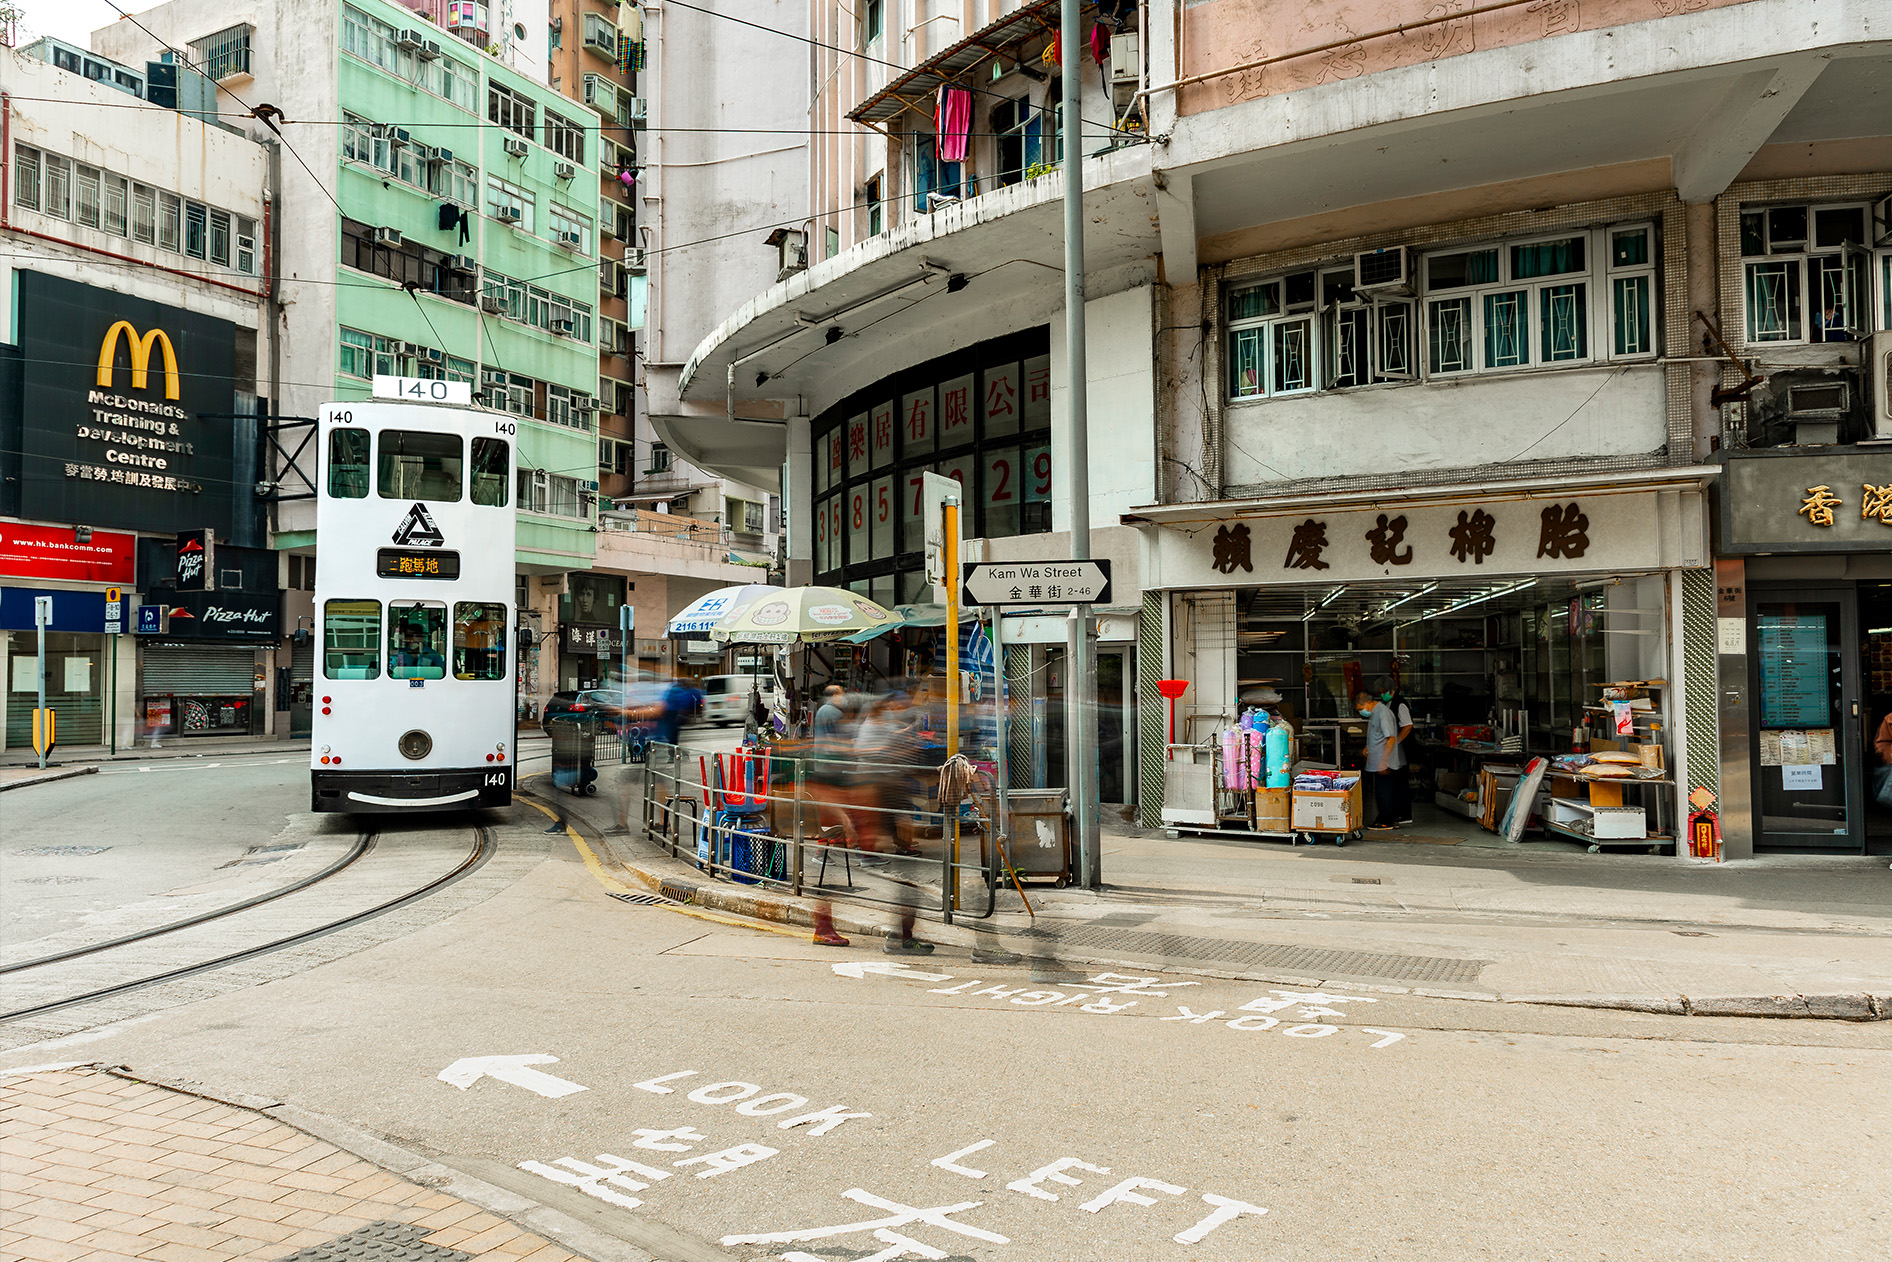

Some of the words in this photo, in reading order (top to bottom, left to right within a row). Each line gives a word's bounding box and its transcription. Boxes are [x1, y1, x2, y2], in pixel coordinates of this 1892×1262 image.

[398, 379, 448, 399] 140
[87, 390, 186, 419] McDonald's
[93, 408, 166, 435] Training
[168, 423, 180, 435] &
[329, 411, 353, 423] 140
[495, 421, 515, 435] 140
[77, 424, 194, 455] Development
[105, 449, 168, 469] Centre
[12, 539, 113, 553] www.hk.bankcomm.com
[178, 553, 203, 573] Pizza
[399, 557, 439, 574] 跑馬地
[182, 564, 202, 582] Hut
[988, 568, 1016, 580] Kam
[1020, 567, 1040, 579] Wa
[1044, 566, 1083, 579] Street
[1008, 585, 1062, 600] 金華街
[1067, 586, 1091, 596] 2-46
[203, 606, 242, 622] Pizza
[240, 609, 271, 623] Hut
[676, 622, 697, 631] 2116
[571, 628, 596, 647] 海洋
[485, 773, 505, 786] 140
[927, 980, 1138, 1015] RIGHT
[1160, 1006, 1406, 1049] LOOK
[633, 1069, 872, 1136] LOOK
[931, 1139, 1269, 1244] LEFT
